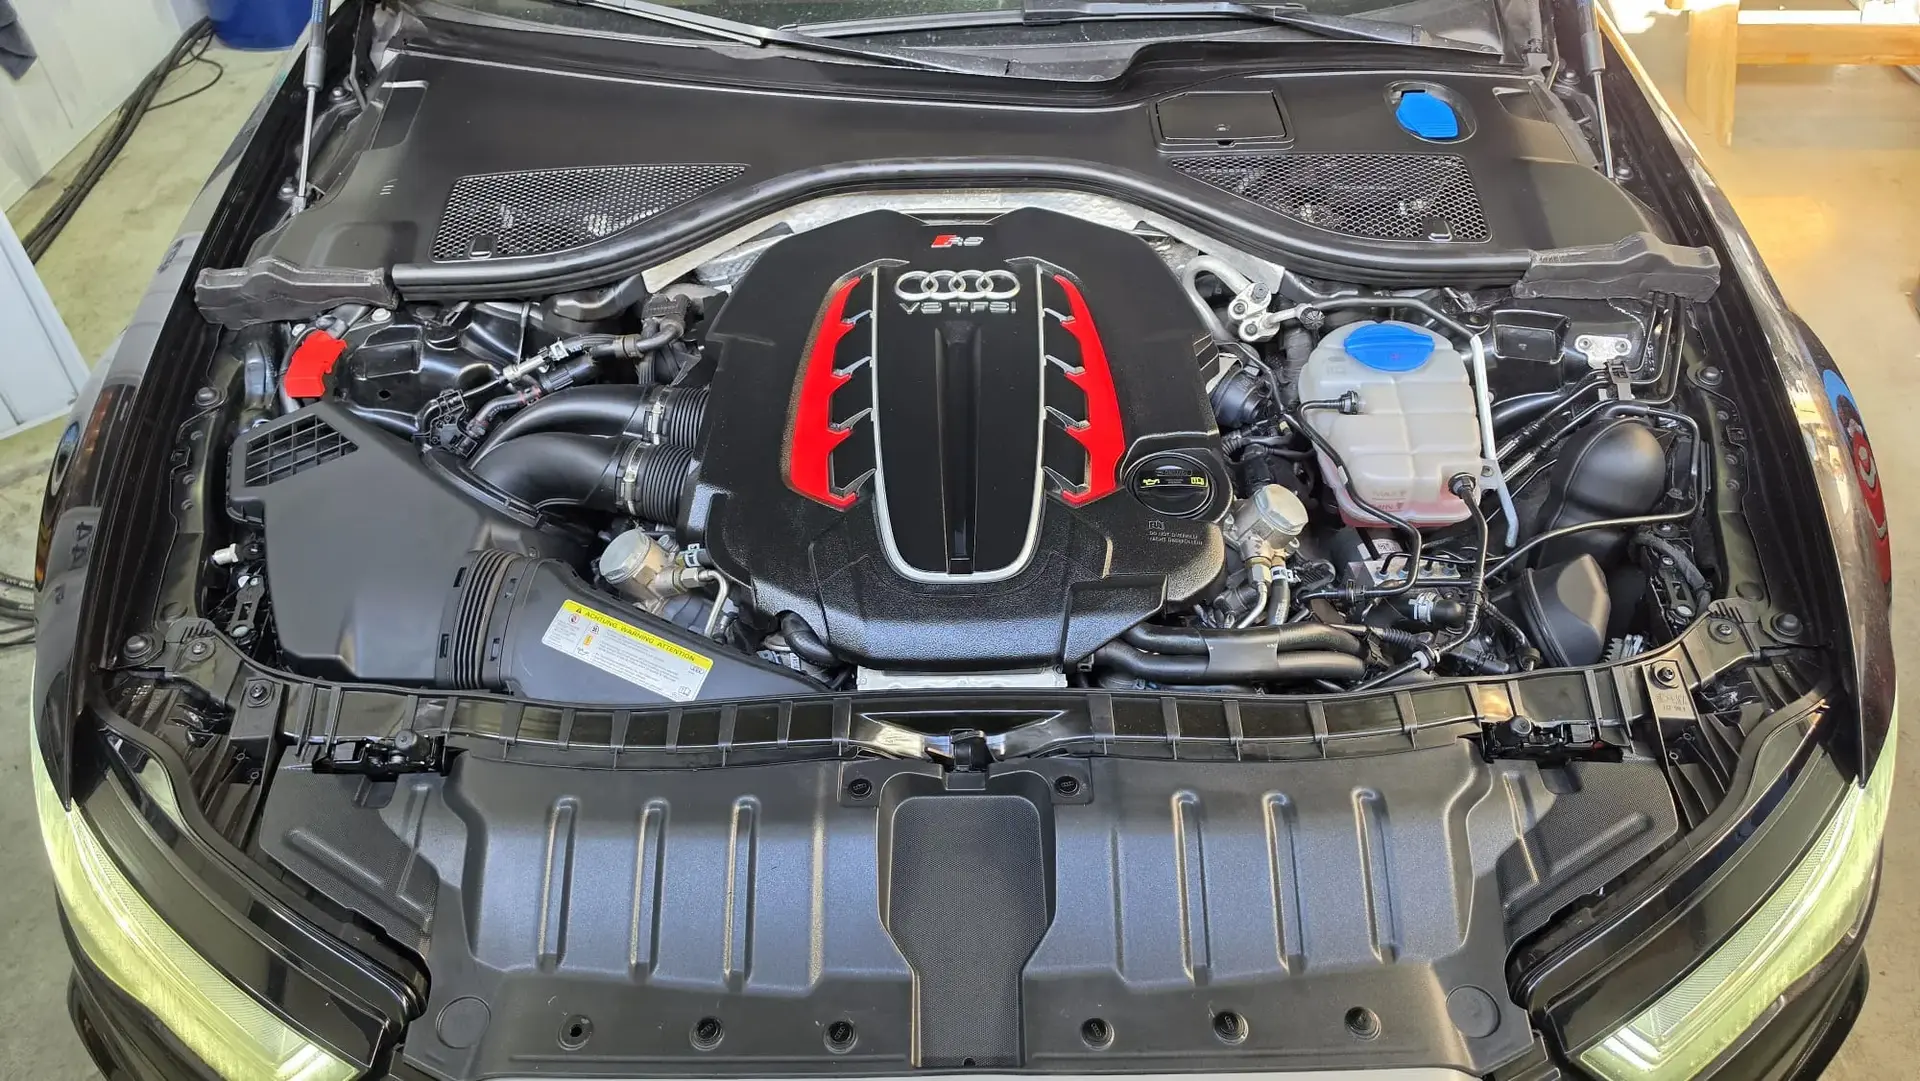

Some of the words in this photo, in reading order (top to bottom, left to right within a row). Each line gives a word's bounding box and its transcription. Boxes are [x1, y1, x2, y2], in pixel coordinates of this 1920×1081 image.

[937, 234, 984, 247] RS
[899, 302, 943, 314] V8
[949, 302, 1017, 314] TFSI
[585, 611, 618, 629] ACHTUNG
[620, 625, 655, 644] WARNING
[656, 641, 695, 661] ATTENTION
